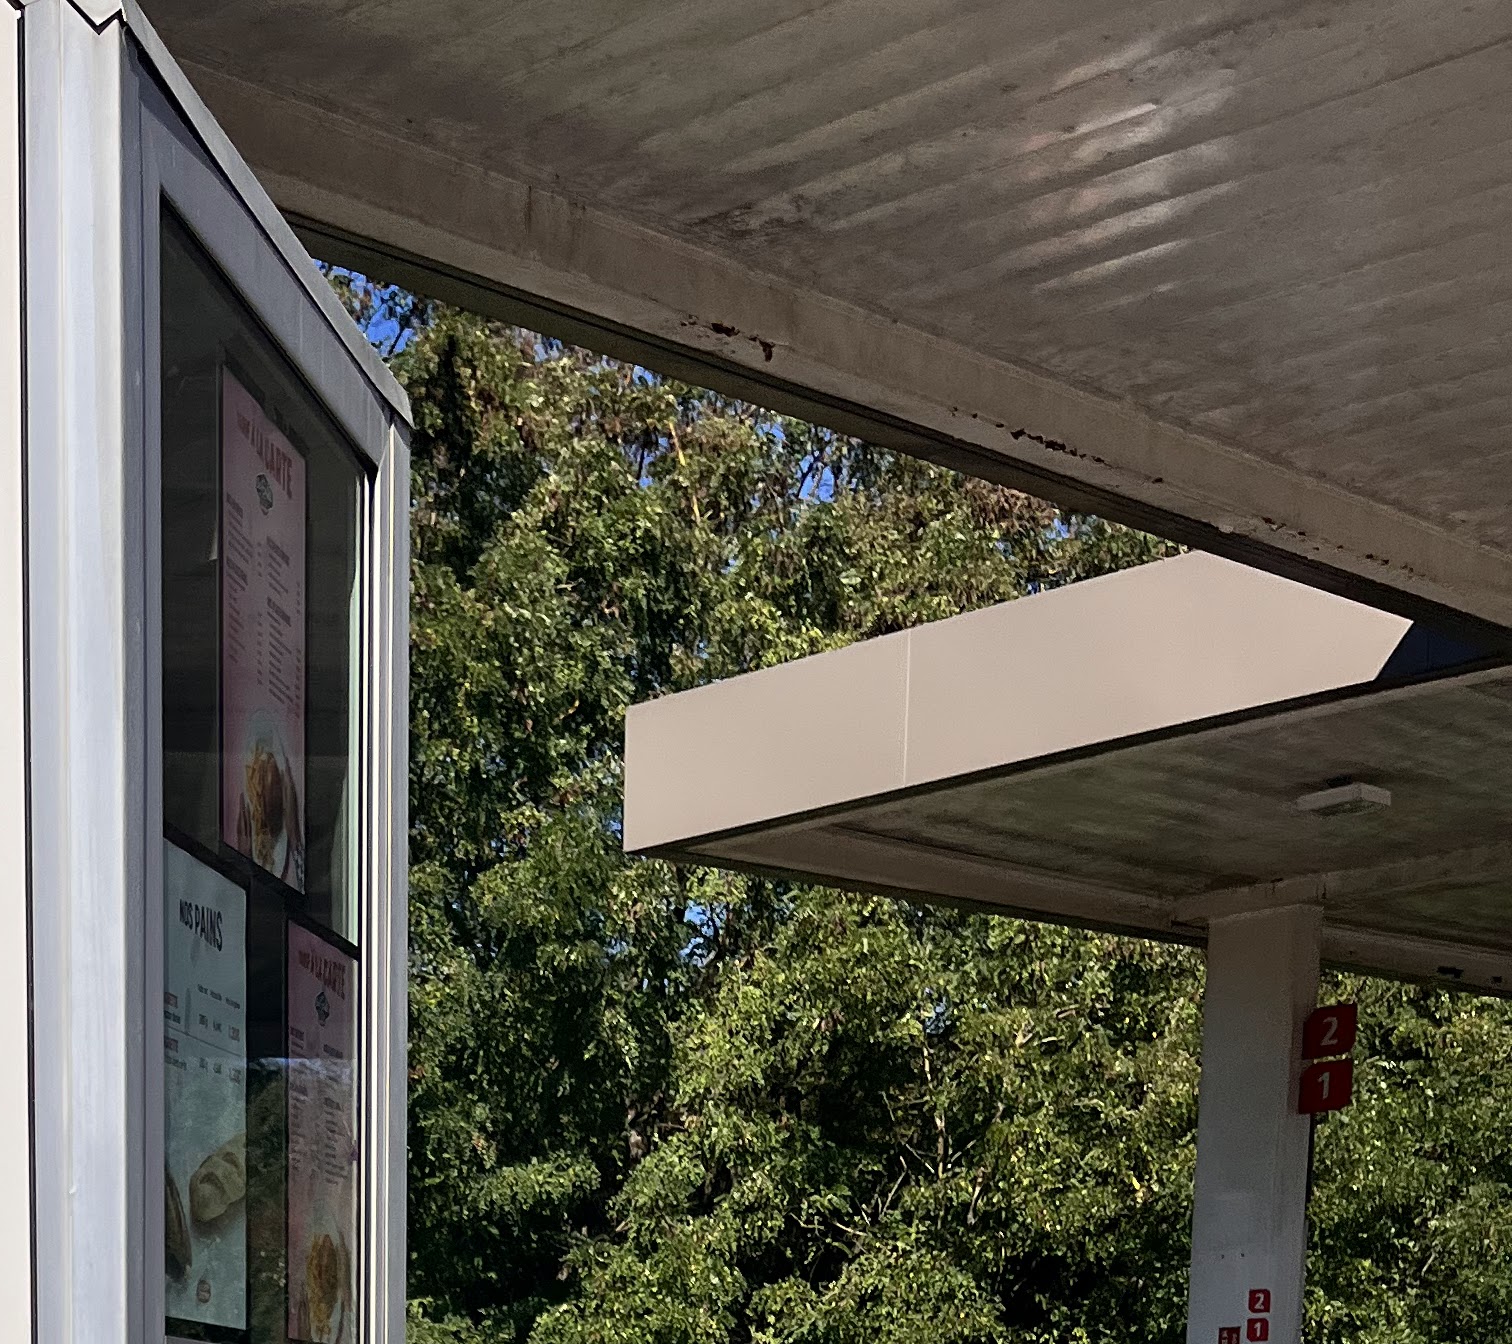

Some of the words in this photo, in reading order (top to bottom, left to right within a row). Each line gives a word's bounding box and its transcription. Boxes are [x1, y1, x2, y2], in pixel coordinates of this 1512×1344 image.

[194, 903, 223, 952] PAINS
[1320, 1015, 1339, 1047] 2
[1316, 1070, 1330, 1100] 1
[1253, 1292, 1265, 1310] 2
[1254, 1322, 1262, 1338] 1
